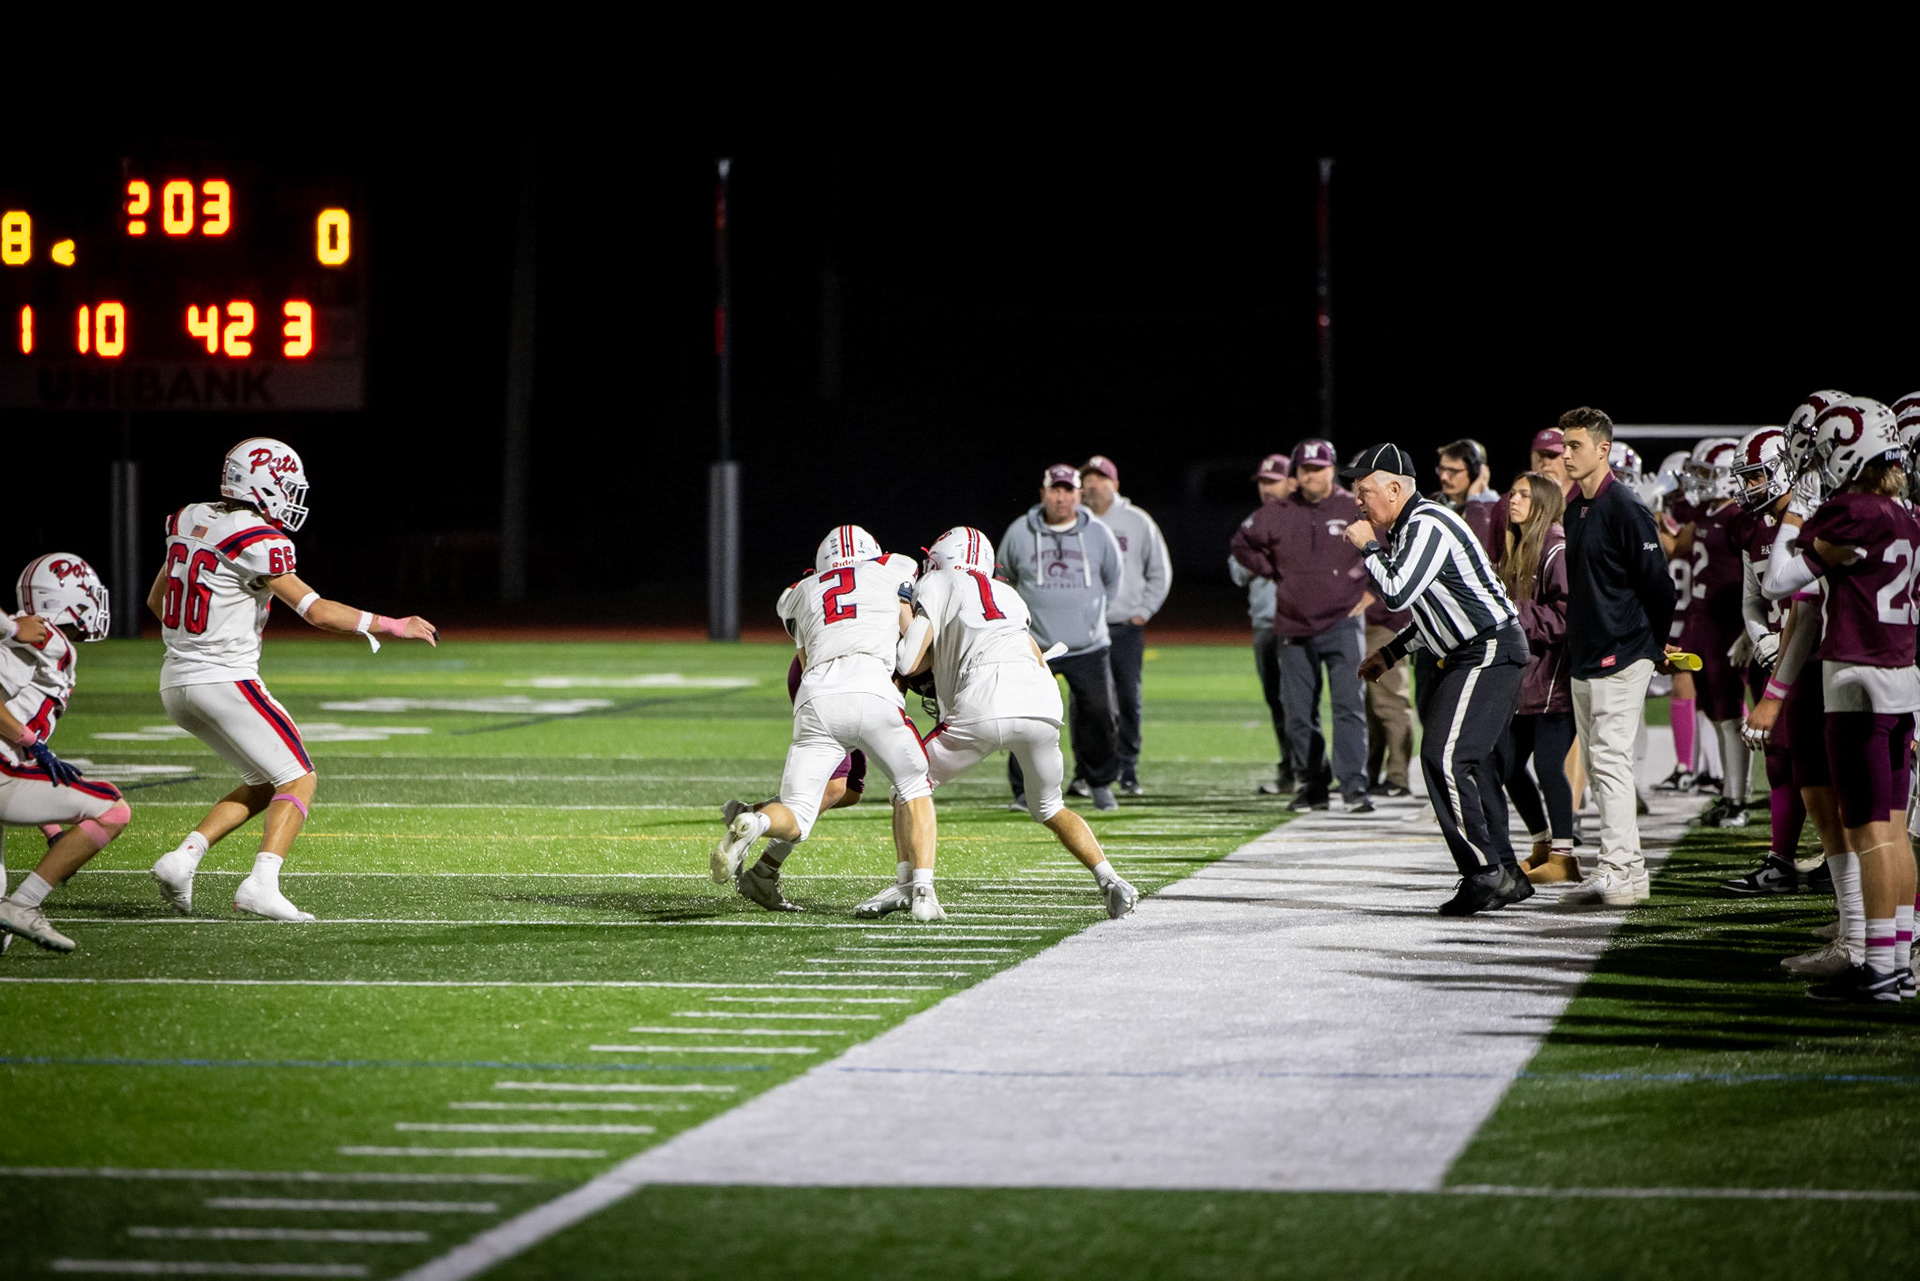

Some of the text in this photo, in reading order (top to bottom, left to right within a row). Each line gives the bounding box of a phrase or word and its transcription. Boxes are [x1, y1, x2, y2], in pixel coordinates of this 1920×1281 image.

[316, 208, 350, 265] 0
[21, 304, 33, 354] 1
[78, 301, 125, 356] 10
[187, 300, 255, 357] 42
[283, 300, 312, 357] 3
[37, 367, 274, 403] UNIBANK
[248, 446, 299, 475] Pats
[268, 545, 297, 575] 66
[163, 542, 220, 635] 66
[819, 566, 857, 625] 2
[967, 569, 1007, 621] 1
